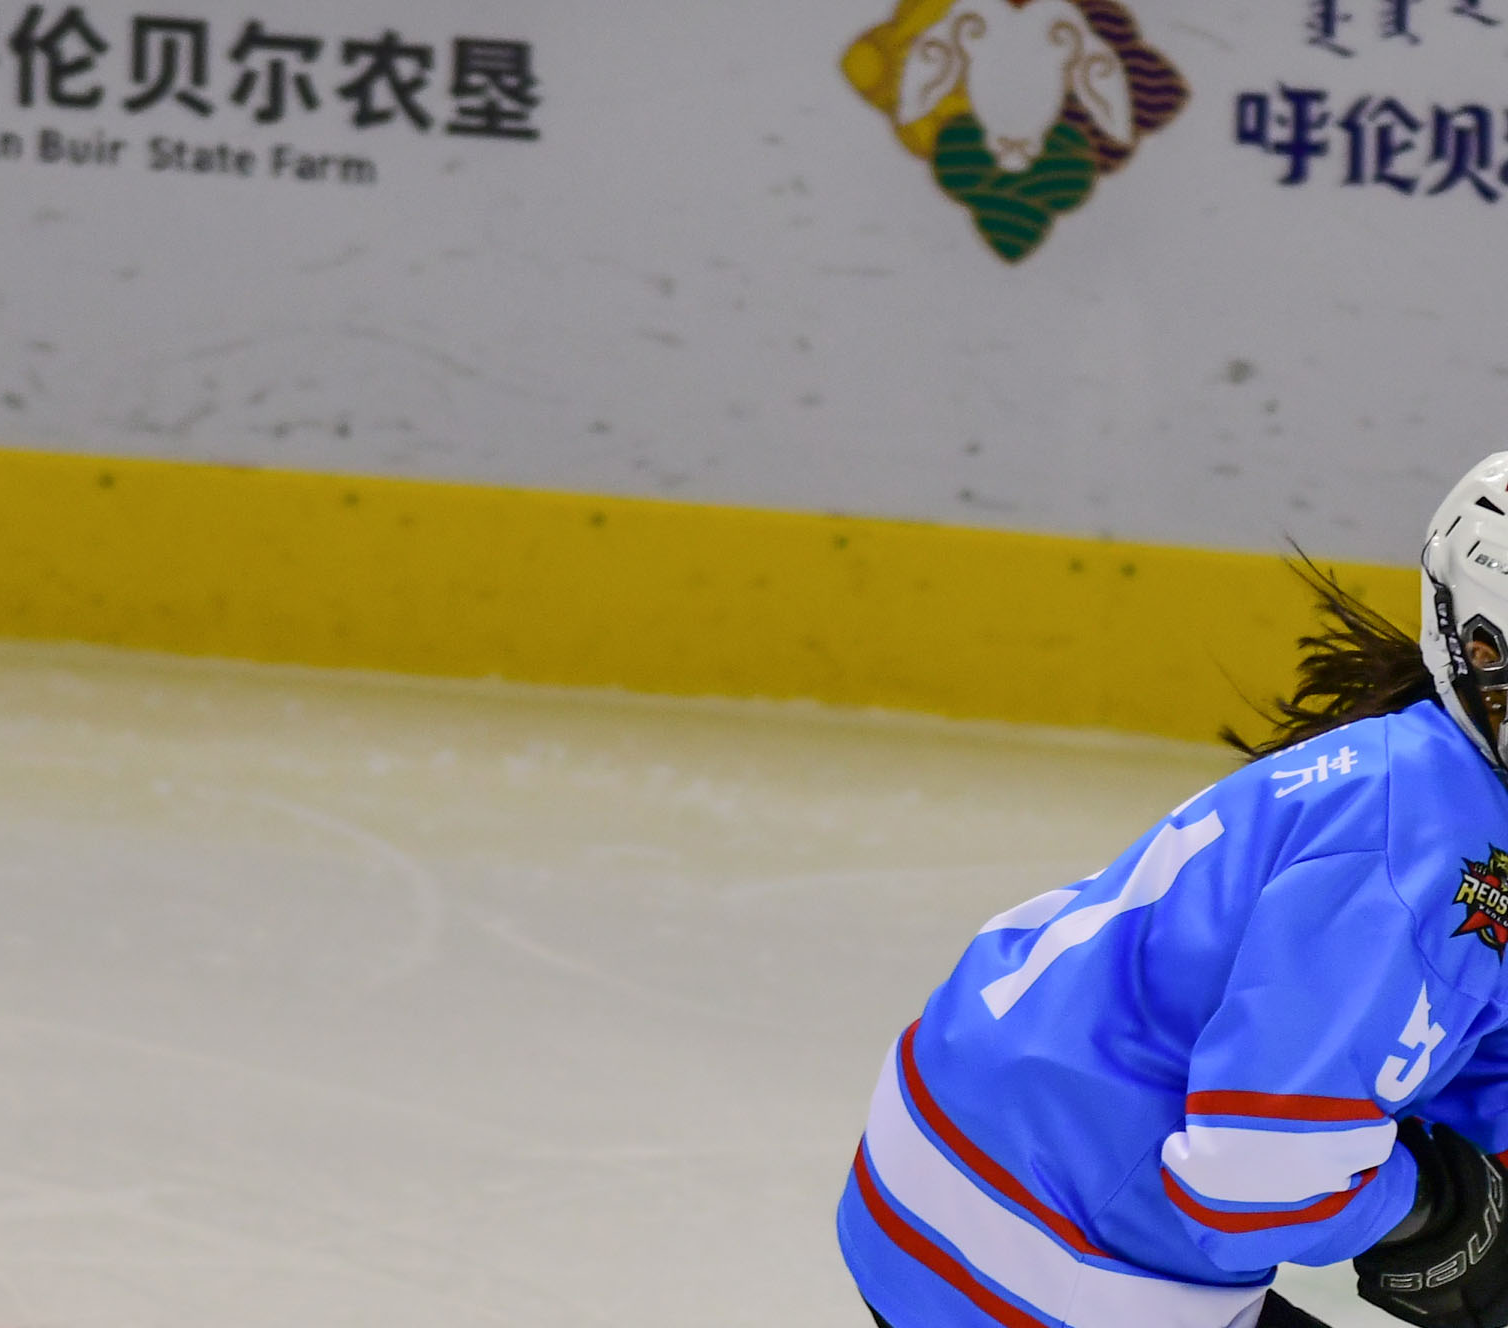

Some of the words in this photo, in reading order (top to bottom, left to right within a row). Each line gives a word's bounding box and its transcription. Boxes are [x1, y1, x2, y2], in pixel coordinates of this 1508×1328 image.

[37, 128, 128, 168] Buir
[148, 136, 256, 177] State
[269, 142, 378, 187] Farm
